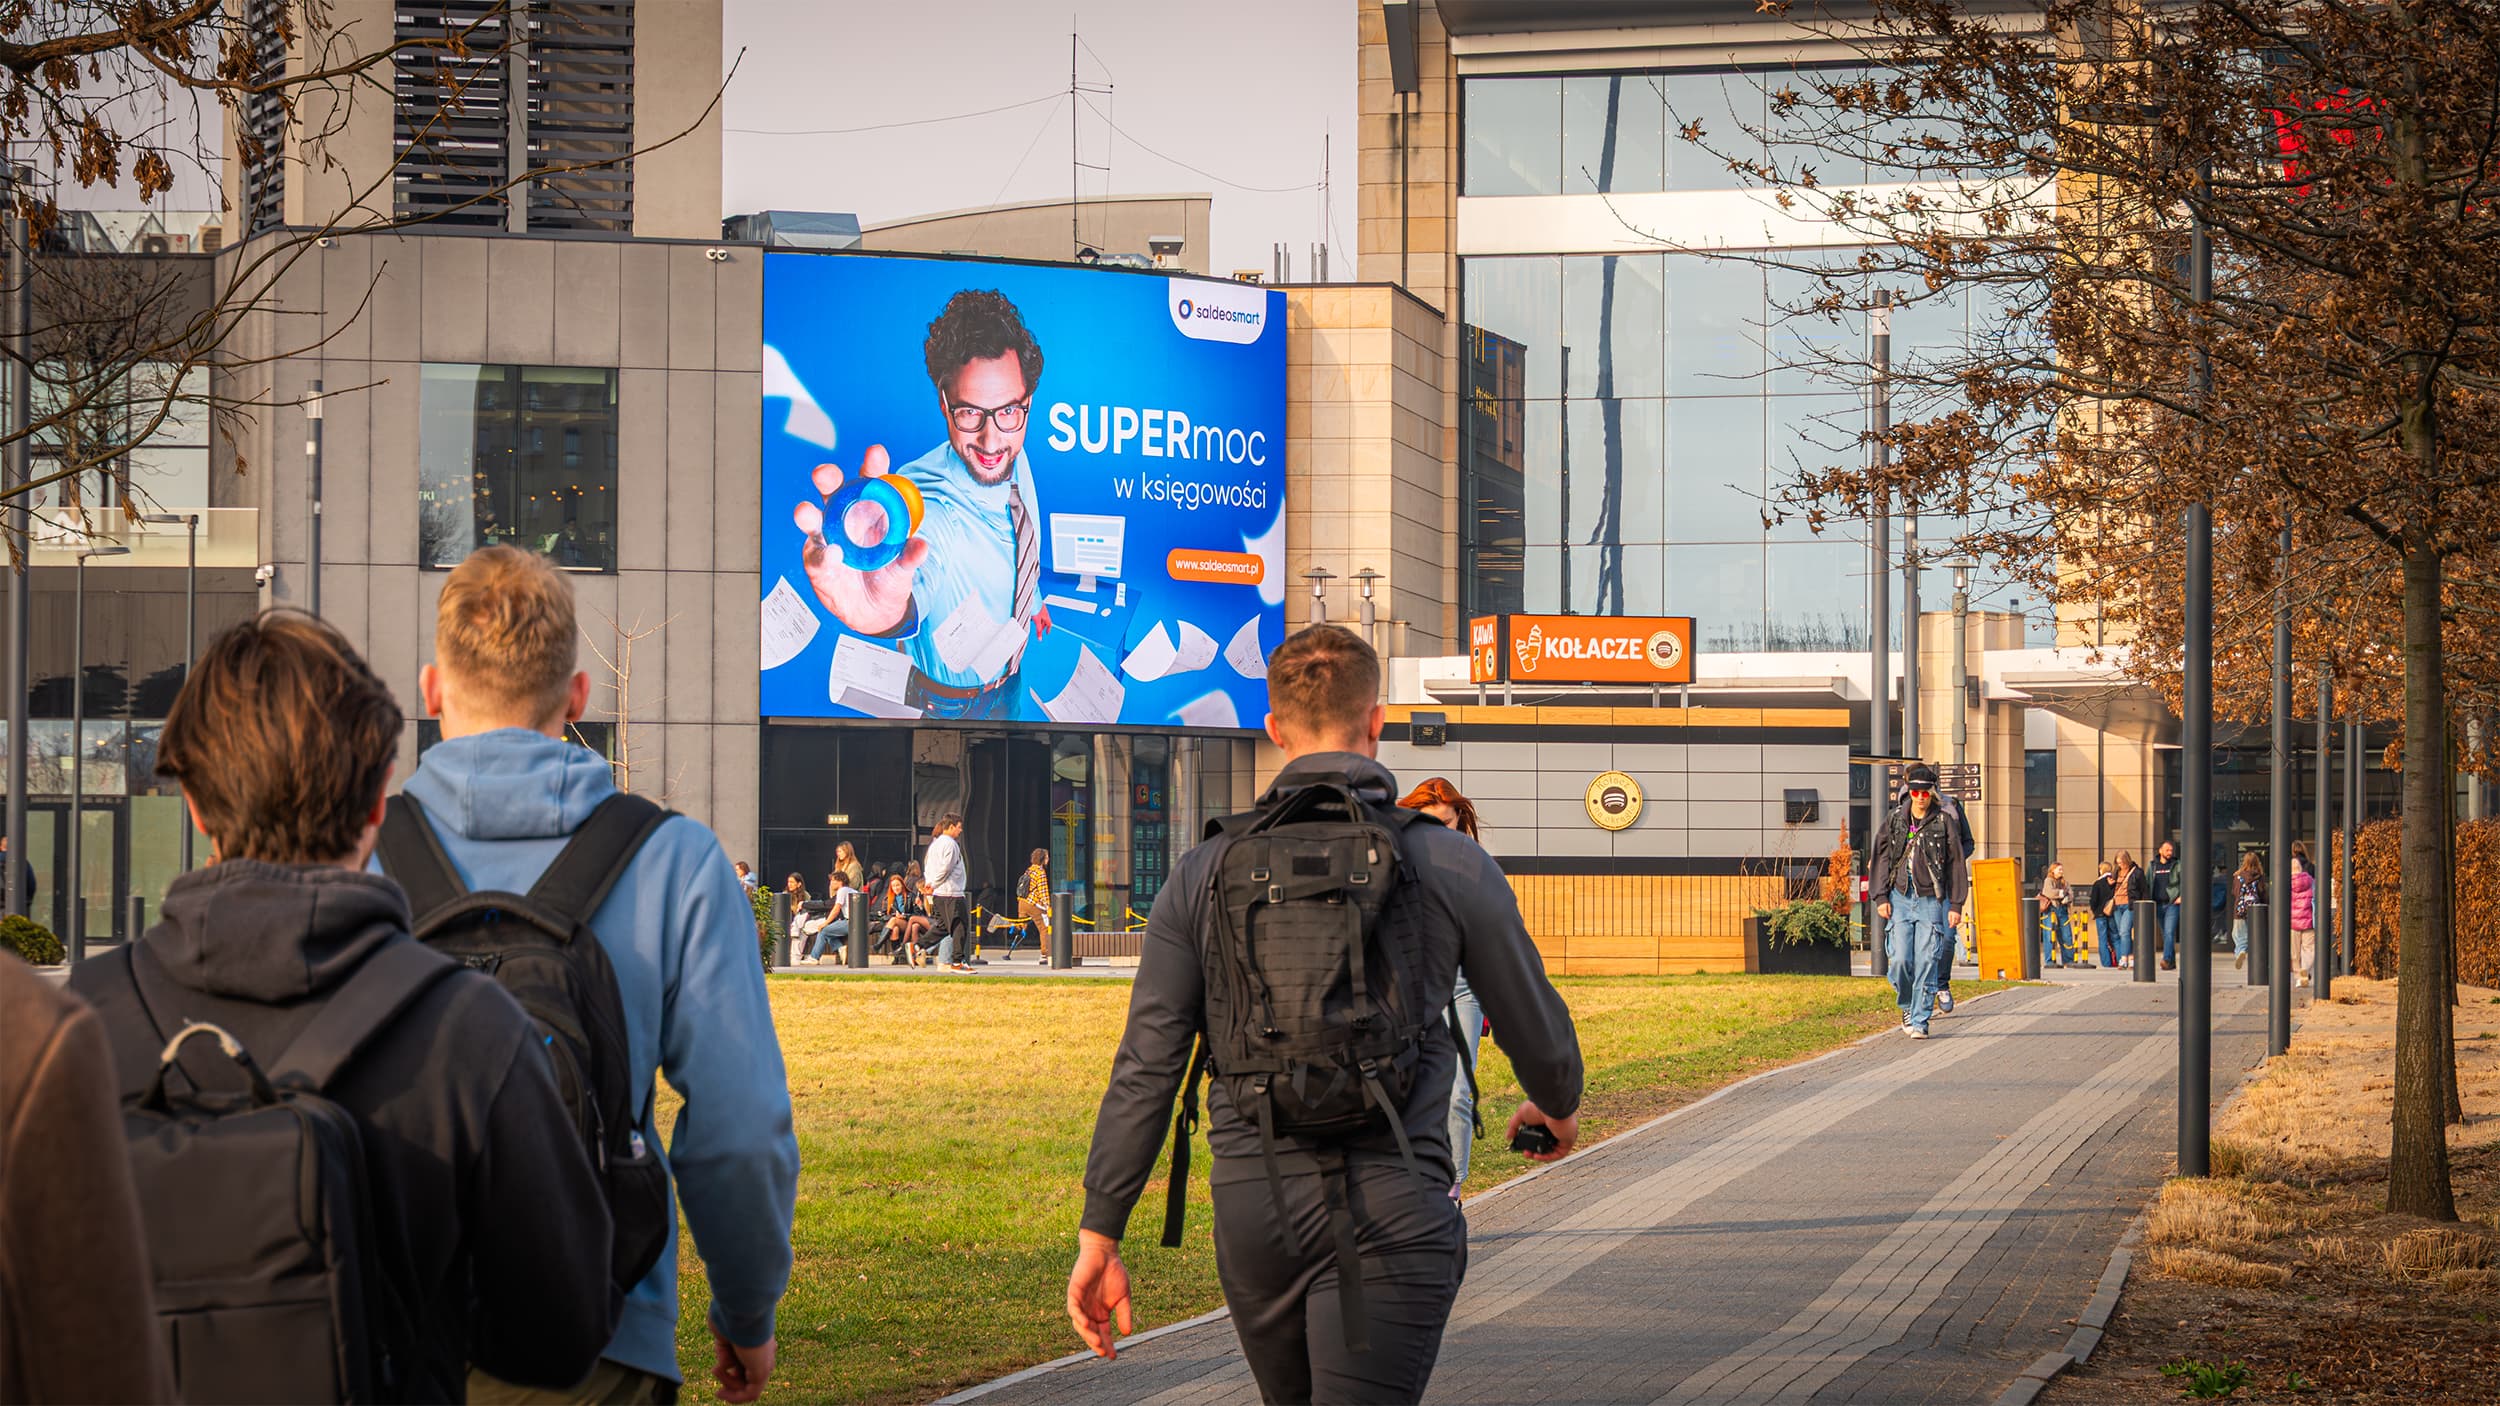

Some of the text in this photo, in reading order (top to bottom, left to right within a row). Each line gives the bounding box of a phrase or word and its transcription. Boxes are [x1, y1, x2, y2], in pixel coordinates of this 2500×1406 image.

[1196, 304, 1260, 325] saldeosmart
[1047, 402, 1267, 466] SUPERmoc
[1113, 471, 1266, 511] w księgowości
[1175, 558, 1259, 576] www.saldeosmart.pl
[1473, 623, 1494, 647] KAWA
[1545, 636, 1644, 660] KOŁACZE
